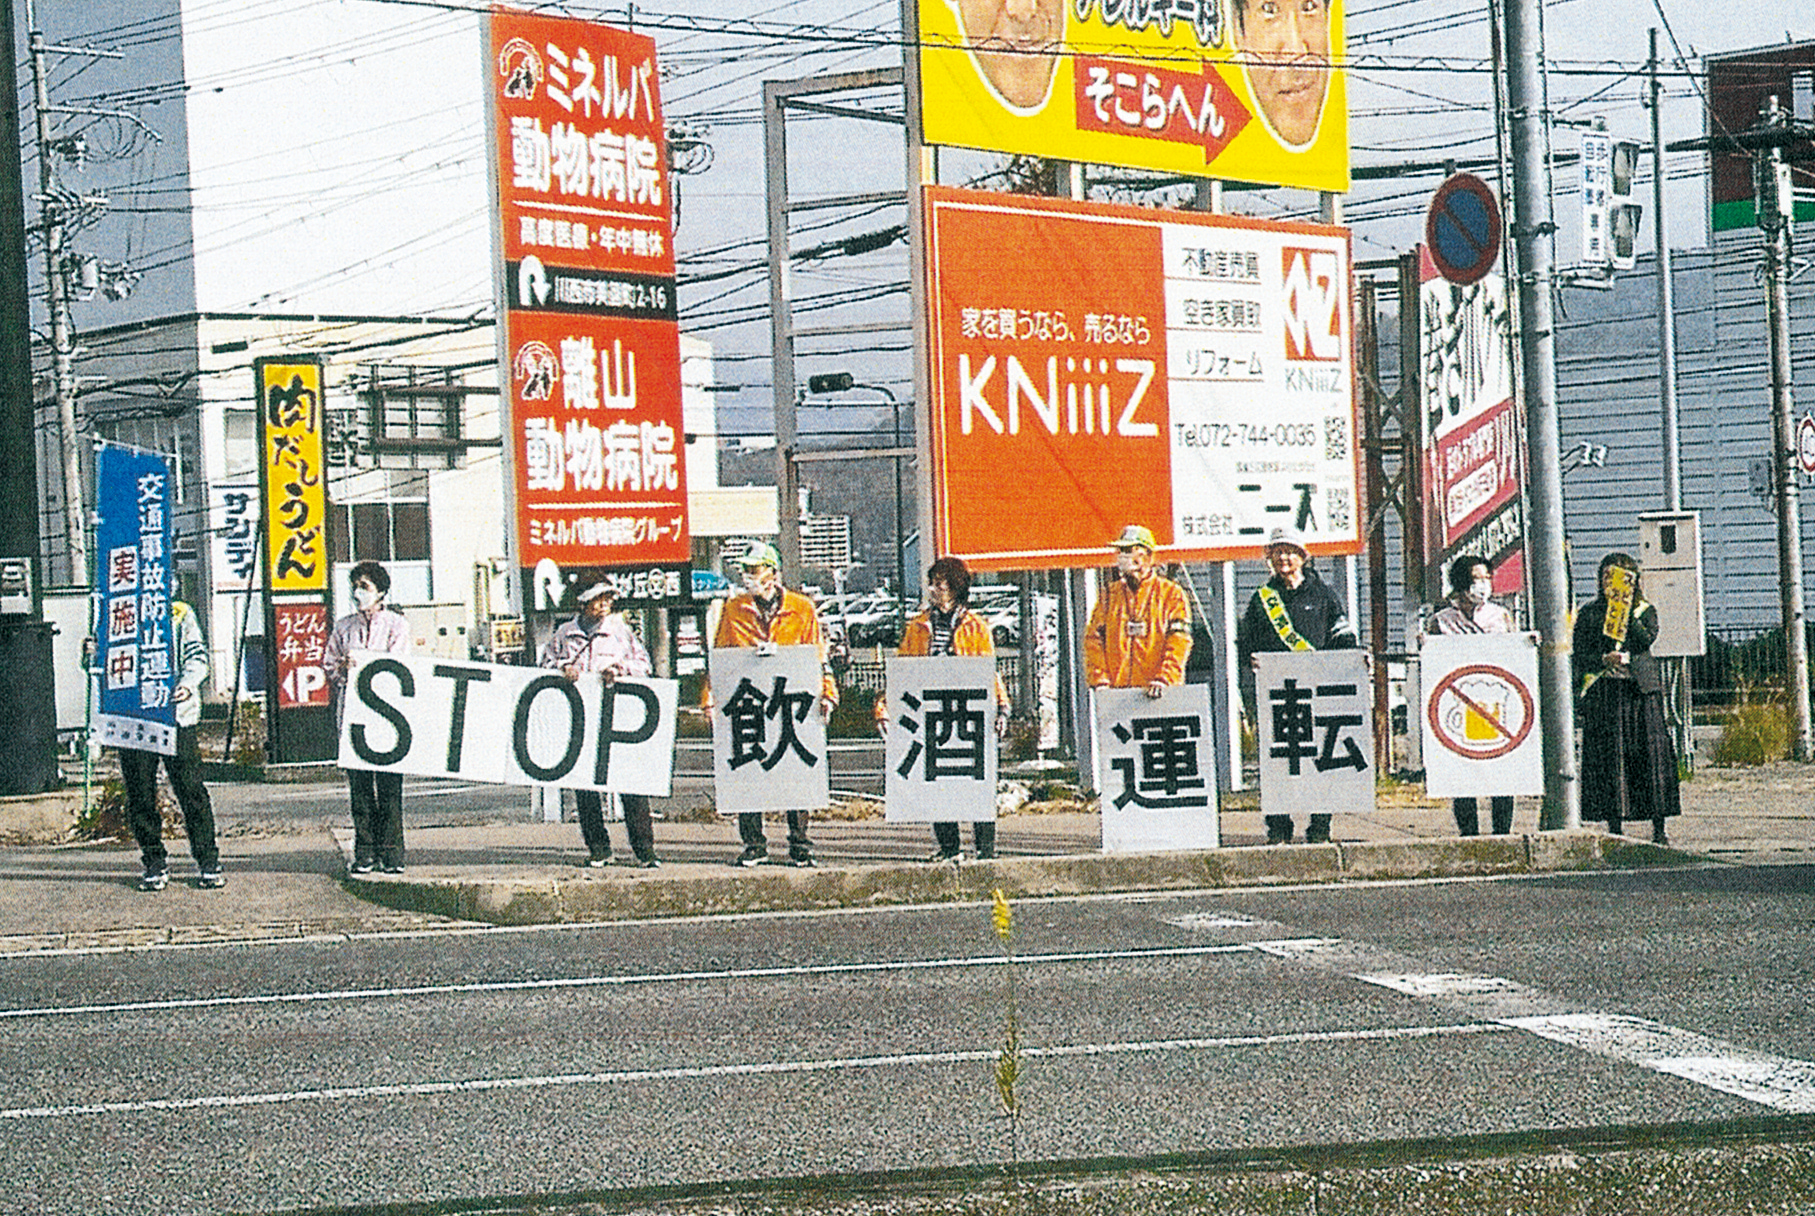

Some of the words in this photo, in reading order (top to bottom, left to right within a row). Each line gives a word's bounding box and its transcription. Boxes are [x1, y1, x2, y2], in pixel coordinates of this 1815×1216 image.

[547, 42, 654, 122] ミネルバ
[1085, 66, 1225, 137] そこらへん
[511, 116, 662, 206] 動物病院
[1182, 247, 1260, 279] 不動産売買
[1183, 299, 1261, 328] 空き家買取
[959, 353, 1159, 437] KNiiiZ
[1186, 349, 1263, 376] リフォーム
[1284, 367, 1343, 393] KNiiiZ
[268, 374, 320, 580] 肉だしうどん
[524, 417, 678, 492] 動物病院
[111, 551, 136, 686] 実施中
[137, 473, 172, 710] 交通事故防止運動
[279, 613, 326, 636] うどん
[280, 635, 324, 663] 弁当
[297, 665, 327, 703] P
[350, 657, 661, 786] STOP
[722, 675, 819, 772] 飲
[896, 688, 988, 782] 酒
[1269, 678, 1369, 776] 転
[1111, 715, 1209, 811] 運
